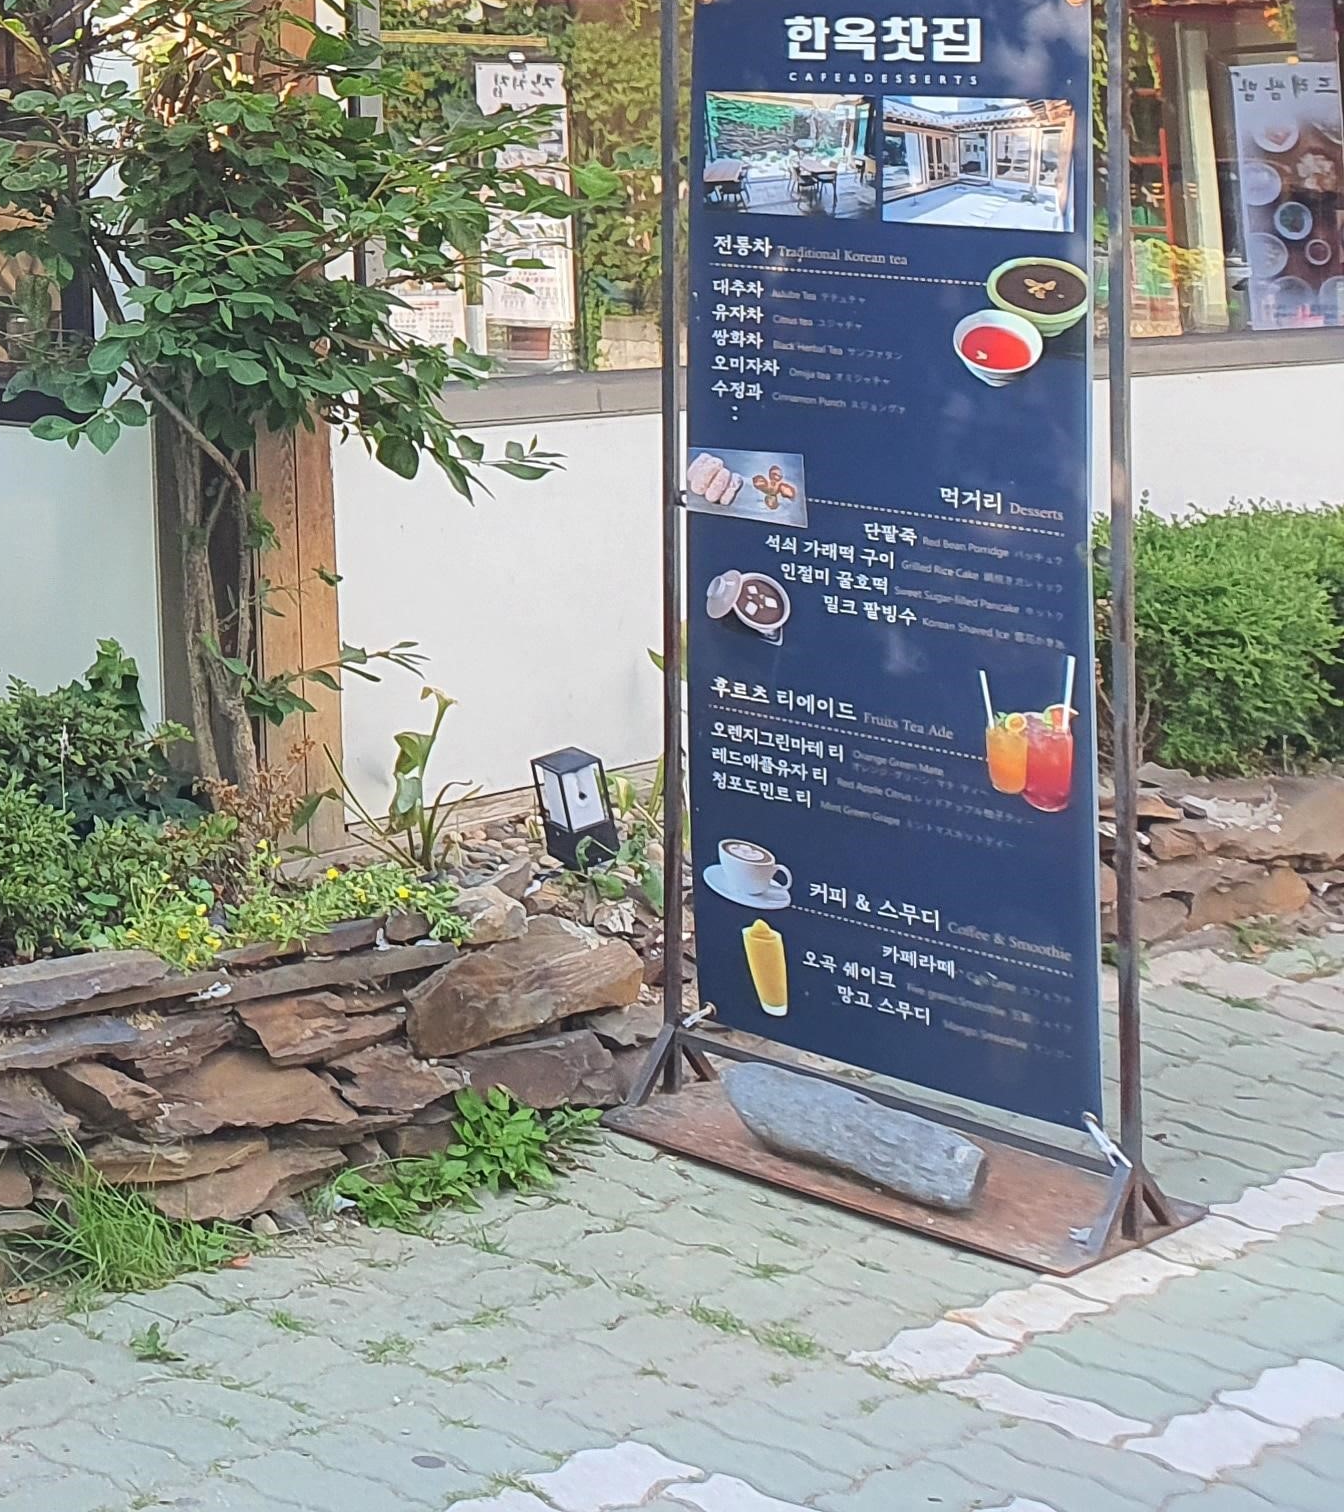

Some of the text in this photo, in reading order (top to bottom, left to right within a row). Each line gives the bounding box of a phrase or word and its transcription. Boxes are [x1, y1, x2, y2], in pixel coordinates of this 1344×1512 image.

[784, 16, 981, 62] 한옥찻집
[788, 72, 978, 85] CAFE&DESSERTS
[713, 235, 773, 258] 전통차
[777, 246, 907, 265] Traditional Korean tea
[712, 279, 764, 298] 대추차
[712, 303, 764, 324] 유자차
[712, 329, 764, 350] 쌍화차
[711, 355, 780, 376] 오미자차
[711, 380, 763, 401] 수정과
[940, 487, 1002, 514] 먹거리
[1009, 502, 1064, 521] Desserts
[765, 534, 894, 570] 석쇠 가래떡 구이
[922, 536, 941, 547] Red
[943, 540, 966, 551] Bean
[780, 562, 888, 595] 인절미 꿀호떡
[901, 559, 932, 573] Grilled
[933, 564, 954, 576] Rice
[823, 595, 858, 615] 밀크
[922, 617, 955, 630] Korean
[710, 676, 857, 720] 후르츠 티에이드
[863, 712, 954, 740] Fruits Tea Ade
[710, 721, 844, 763] 오렌지그린마테 티
[711, 747, 827, 786] 레드애플유자 티
[712, 771, 811, 808] 청포도민트 티
[809, 882, 939, 931] 커피 & 스무디
[948, 921, 1073, 962] Coffee & Smoothie
[802, 951, 896, 988] 오곡 쉐이크
[882, 945, 955, 979] 카페라떼
[837, 985, 930, 1026] 망고 스무디
